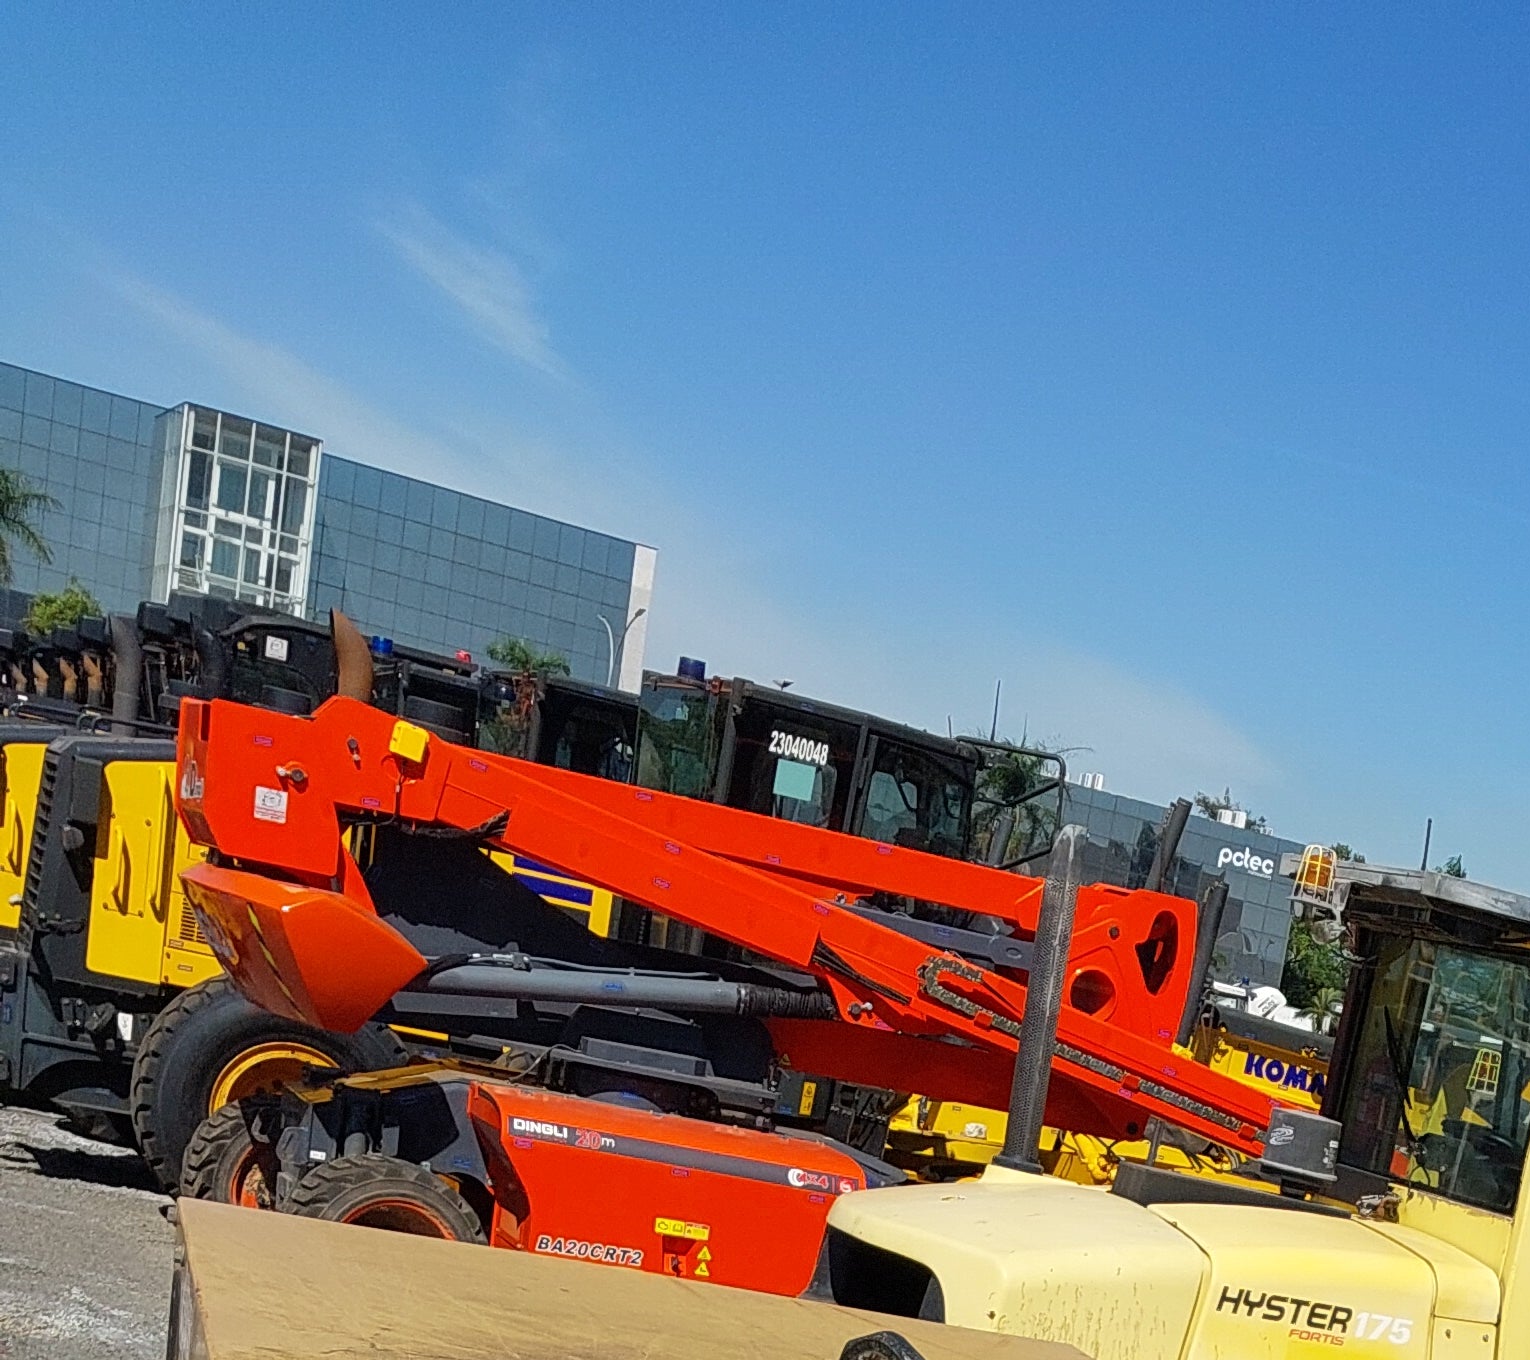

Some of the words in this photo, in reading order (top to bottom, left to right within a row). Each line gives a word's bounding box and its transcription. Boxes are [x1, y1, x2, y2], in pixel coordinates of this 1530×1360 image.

[769, 730, 829, 766] 23040048
[1217, 846, 1274, 875] pctec
[513, 1118, 568, 1139] DINGLI
[536, 1235, 644, 1267] BA20CRT2
[1216, 1286, 1353, 1334] HYSTER
[1353, 1311, 1414, 1345] 175
[1288, 1328, 1345, 1347] FORTIS
